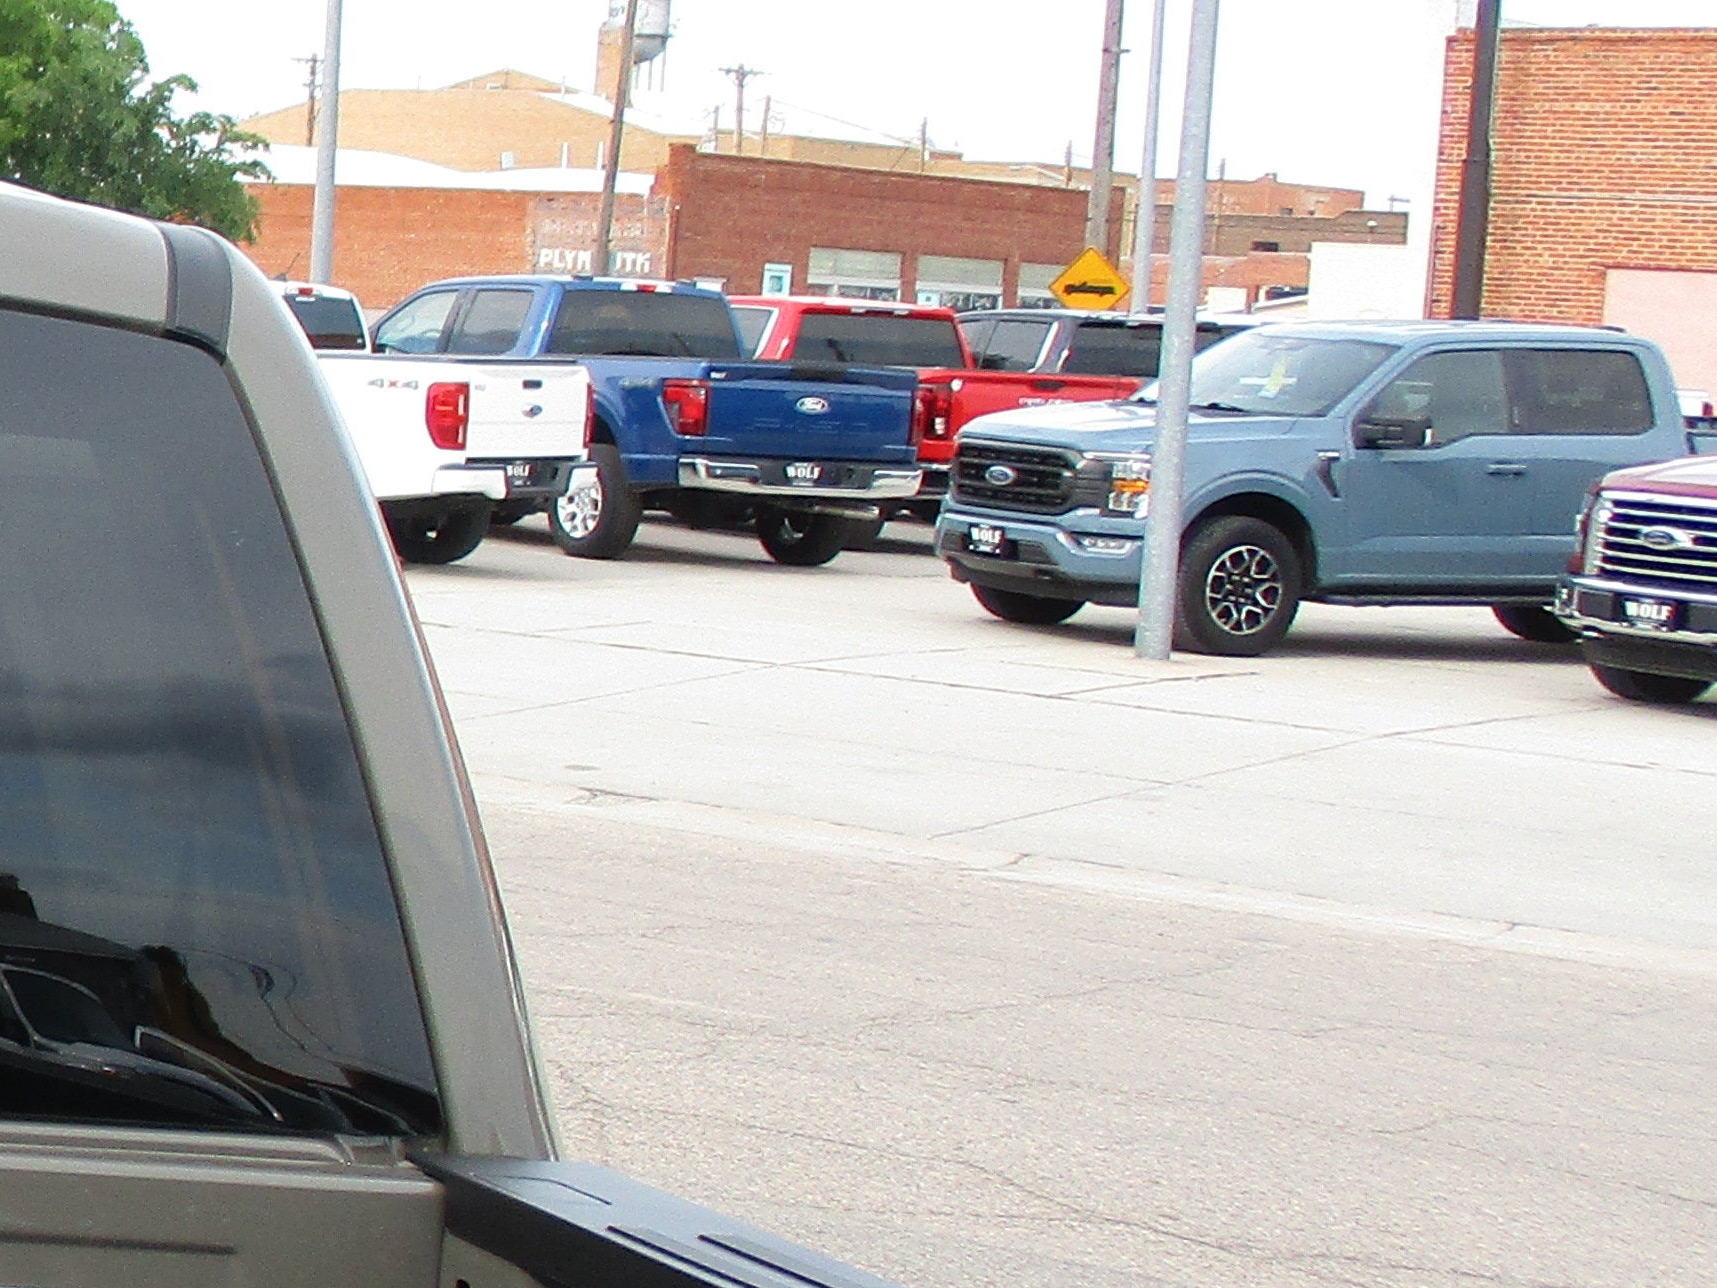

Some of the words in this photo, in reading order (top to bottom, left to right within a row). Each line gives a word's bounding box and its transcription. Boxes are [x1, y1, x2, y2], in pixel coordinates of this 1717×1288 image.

[539, 248, 651, 273] PLYMUTH
[786, 466, 822, 479] WOLF
[970, 527, 1003, 544] WOLF
[1625, 601, 1673, 620] WOLF
